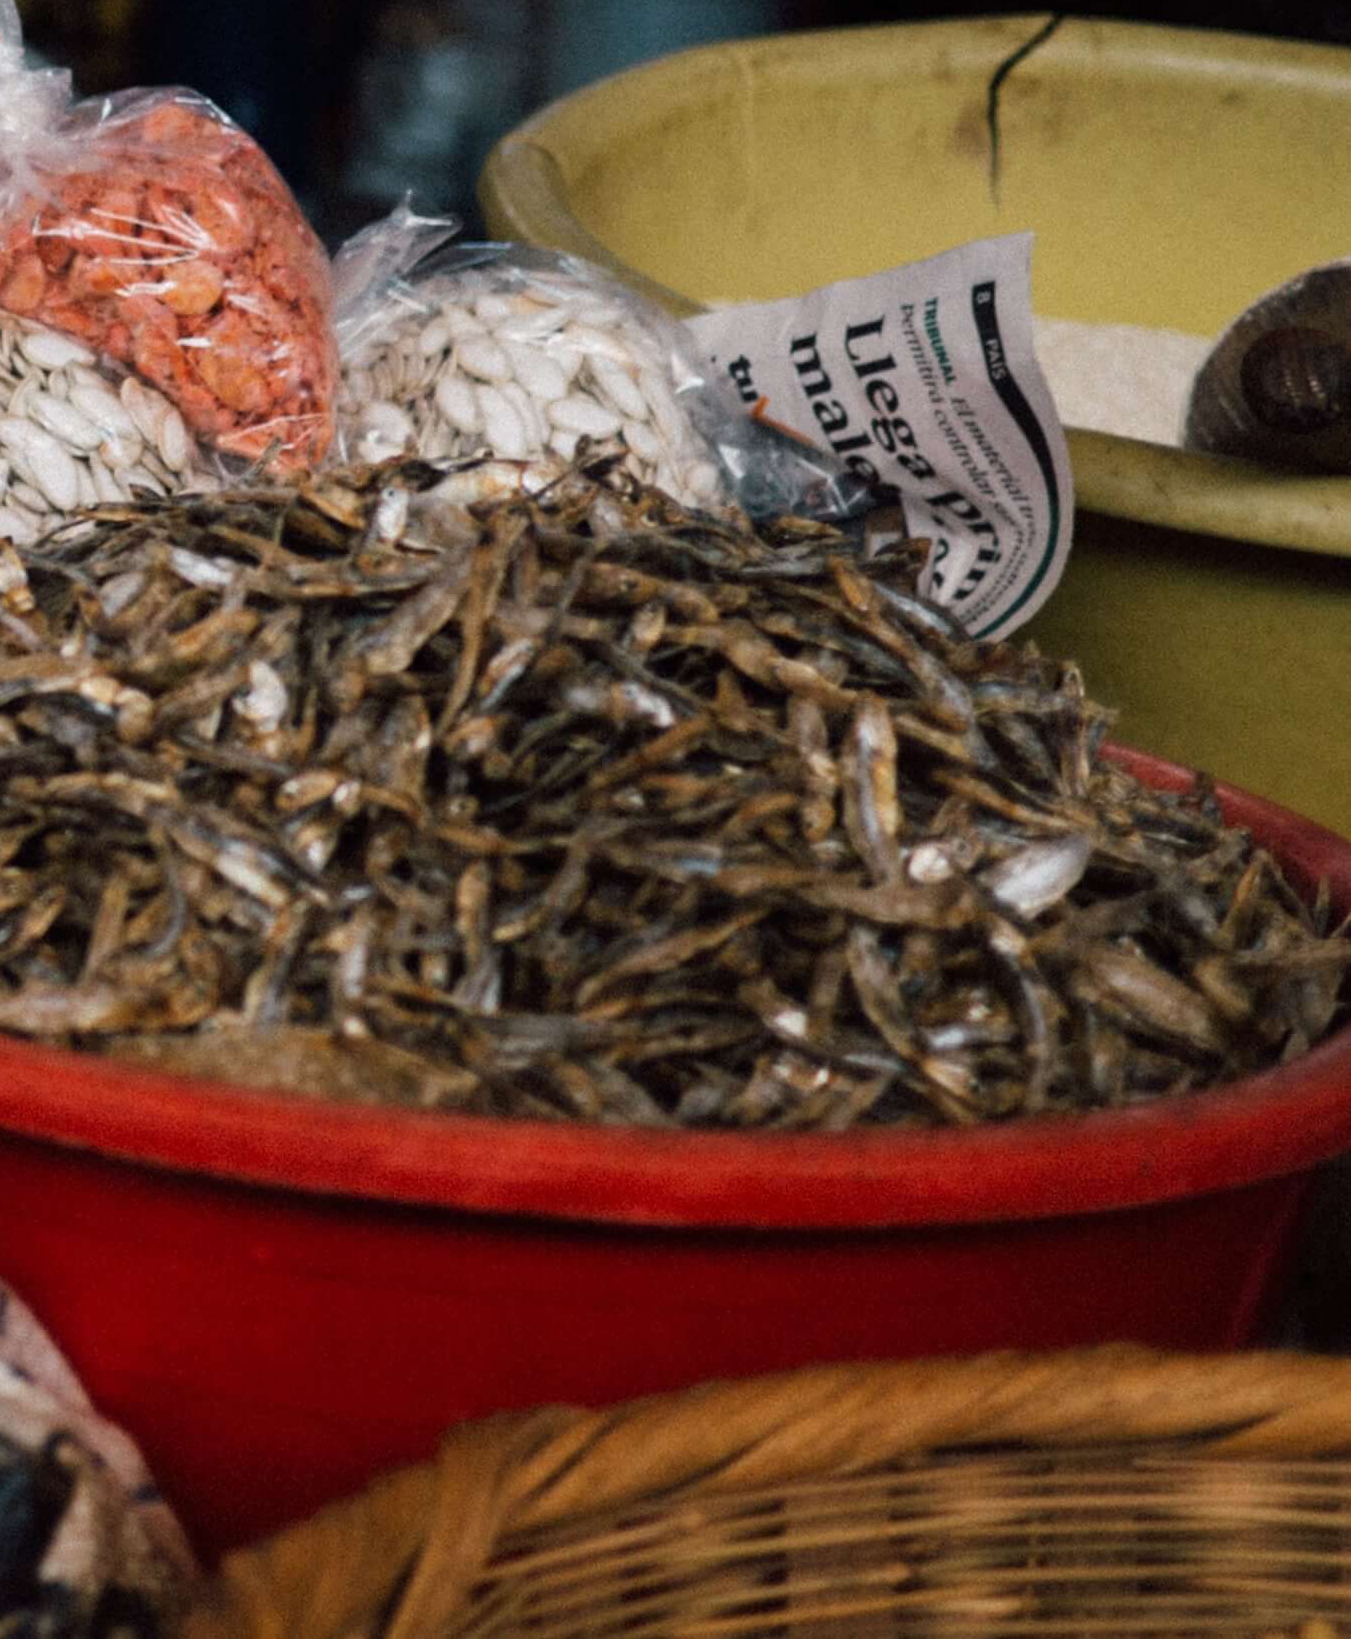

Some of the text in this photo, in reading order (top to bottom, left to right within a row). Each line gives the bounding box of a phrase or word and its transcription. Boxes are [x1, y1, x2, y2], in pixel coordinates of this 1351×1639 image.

[844, 314, 936, 480] Llega
[924, 297, 956, 386] TRIBUNAL
[950, 397, 975, 417] El
[963, 419, 1029, 502] material
[933, 408, 997, 496] controlar
